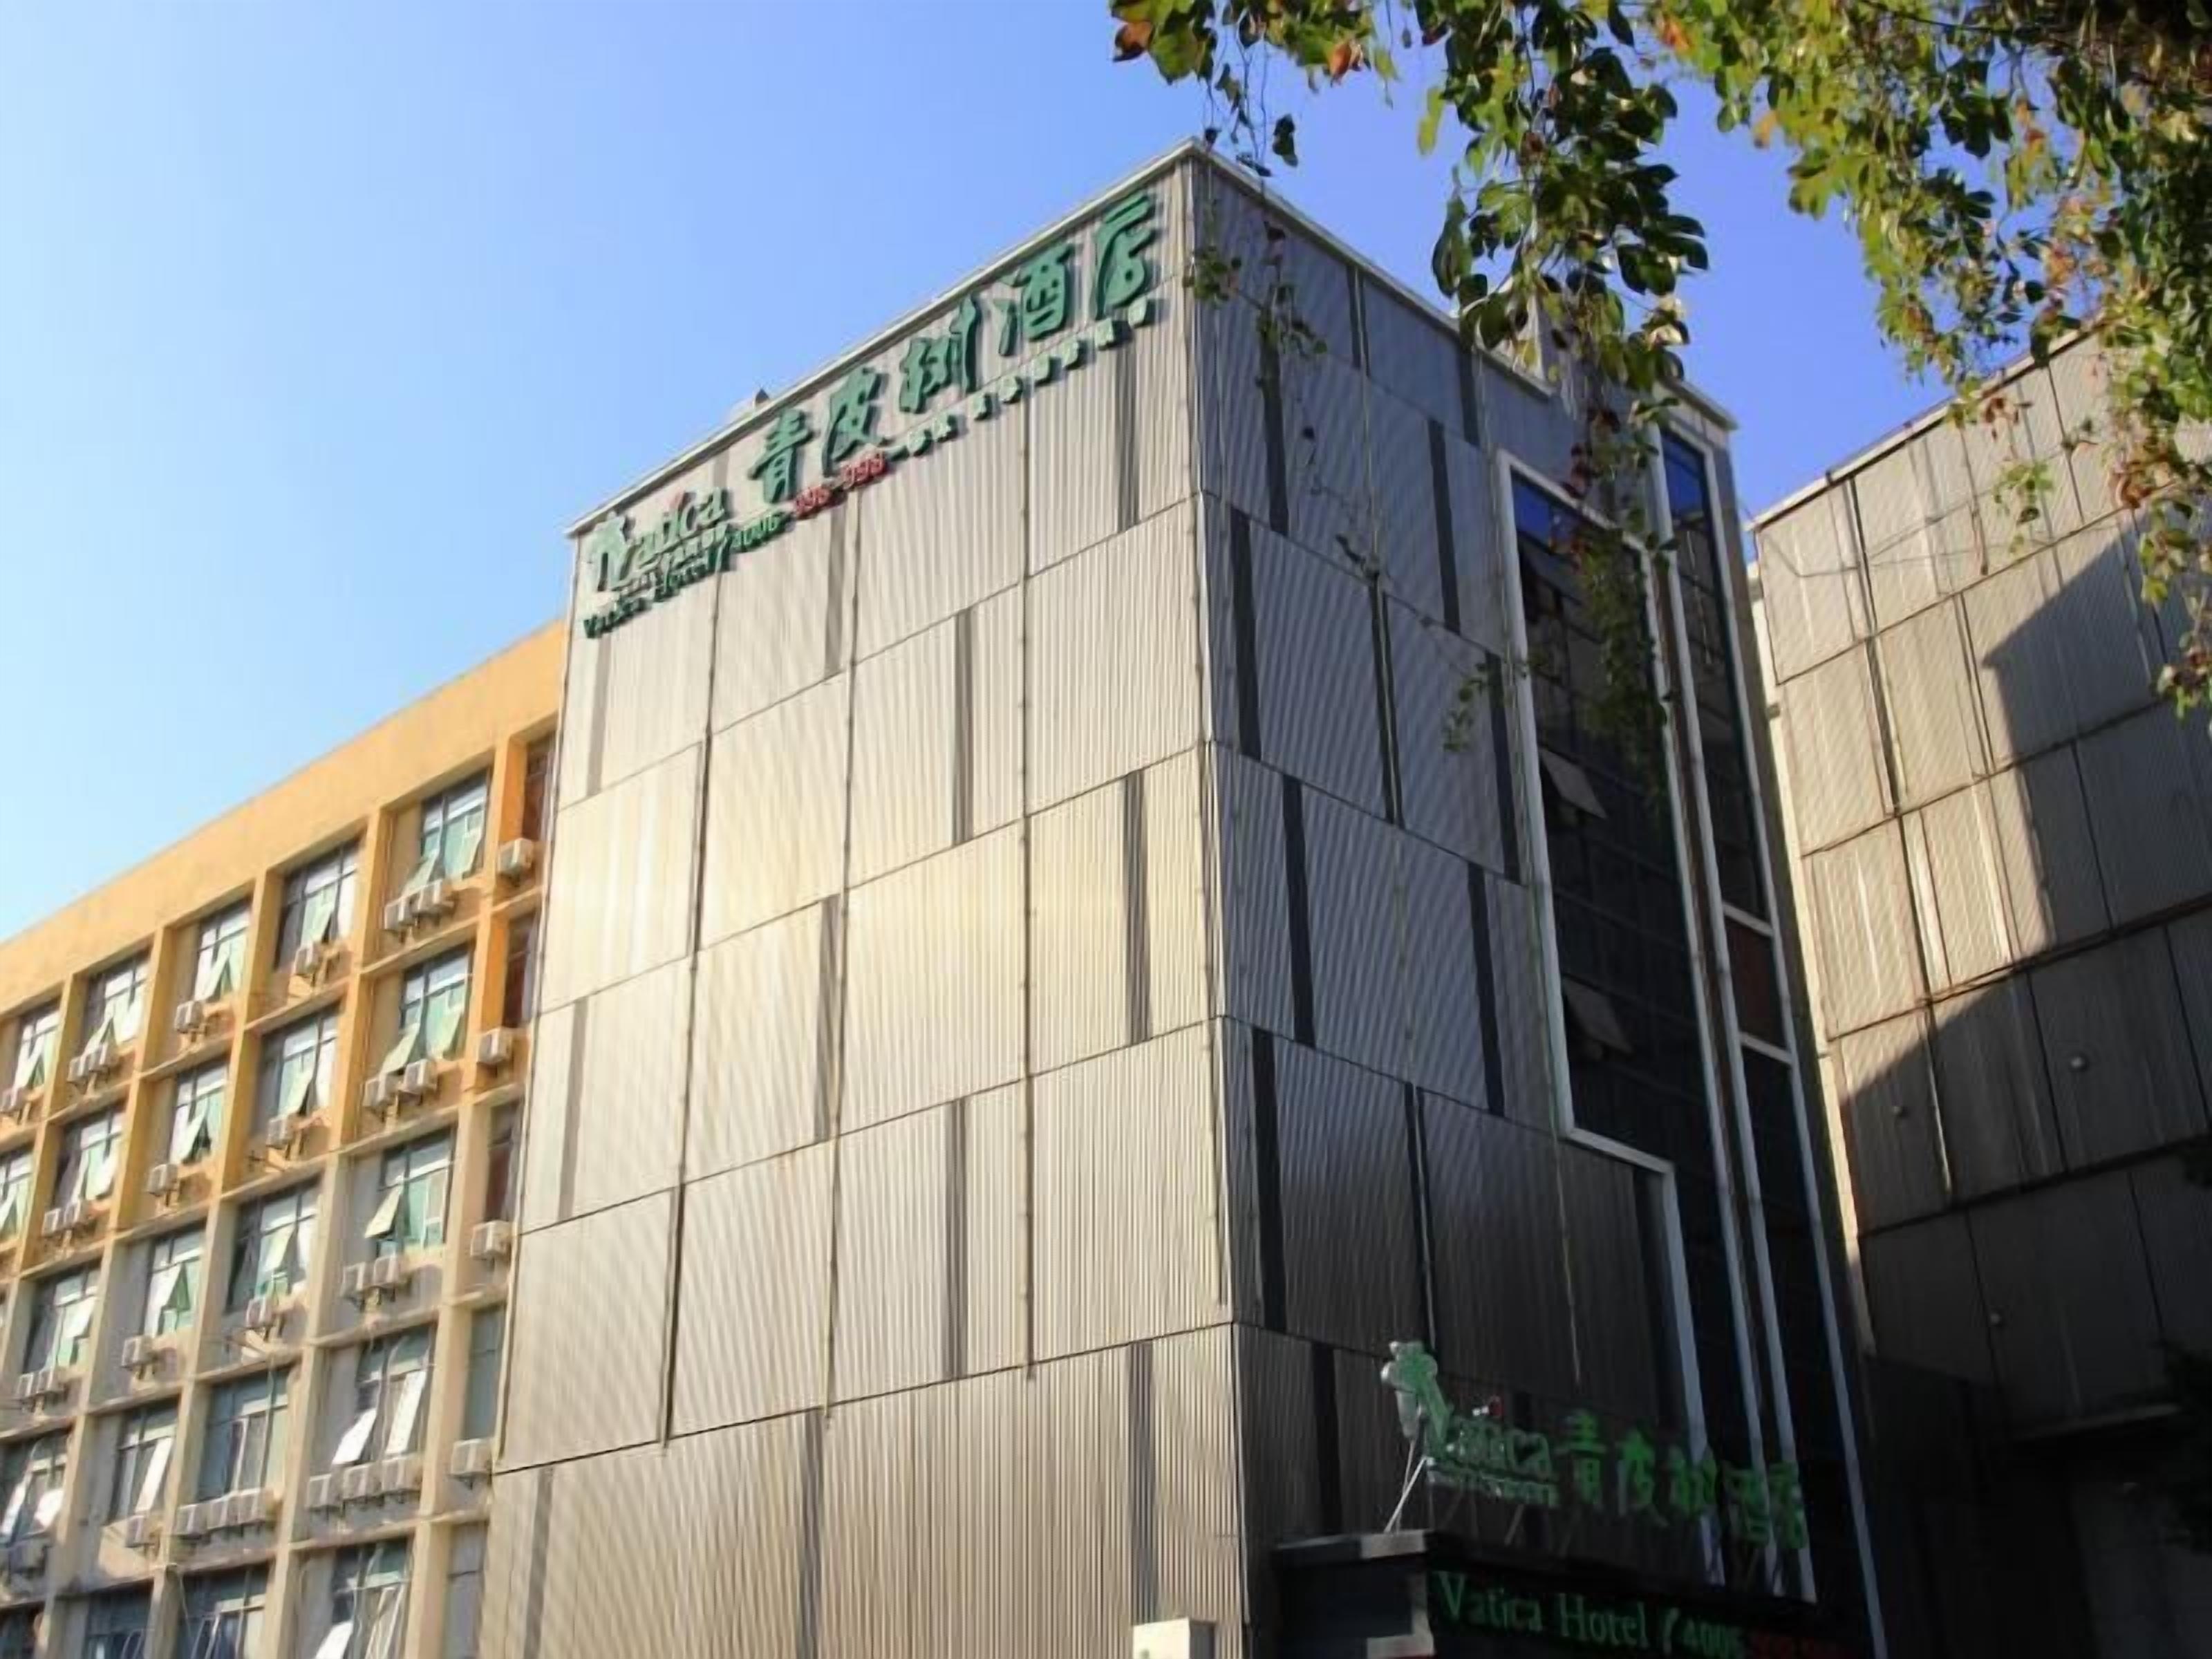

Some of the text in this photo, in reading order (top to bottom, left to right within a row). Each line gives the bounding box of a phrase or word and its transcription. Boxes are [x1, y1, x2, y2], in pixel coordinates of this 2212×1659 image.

[748, 192, 1152, 503] 青皮树酒店
[1434, 1571, 1543, 1632] Vatica
[1559, 1592, 1651, 1650] Hotel
